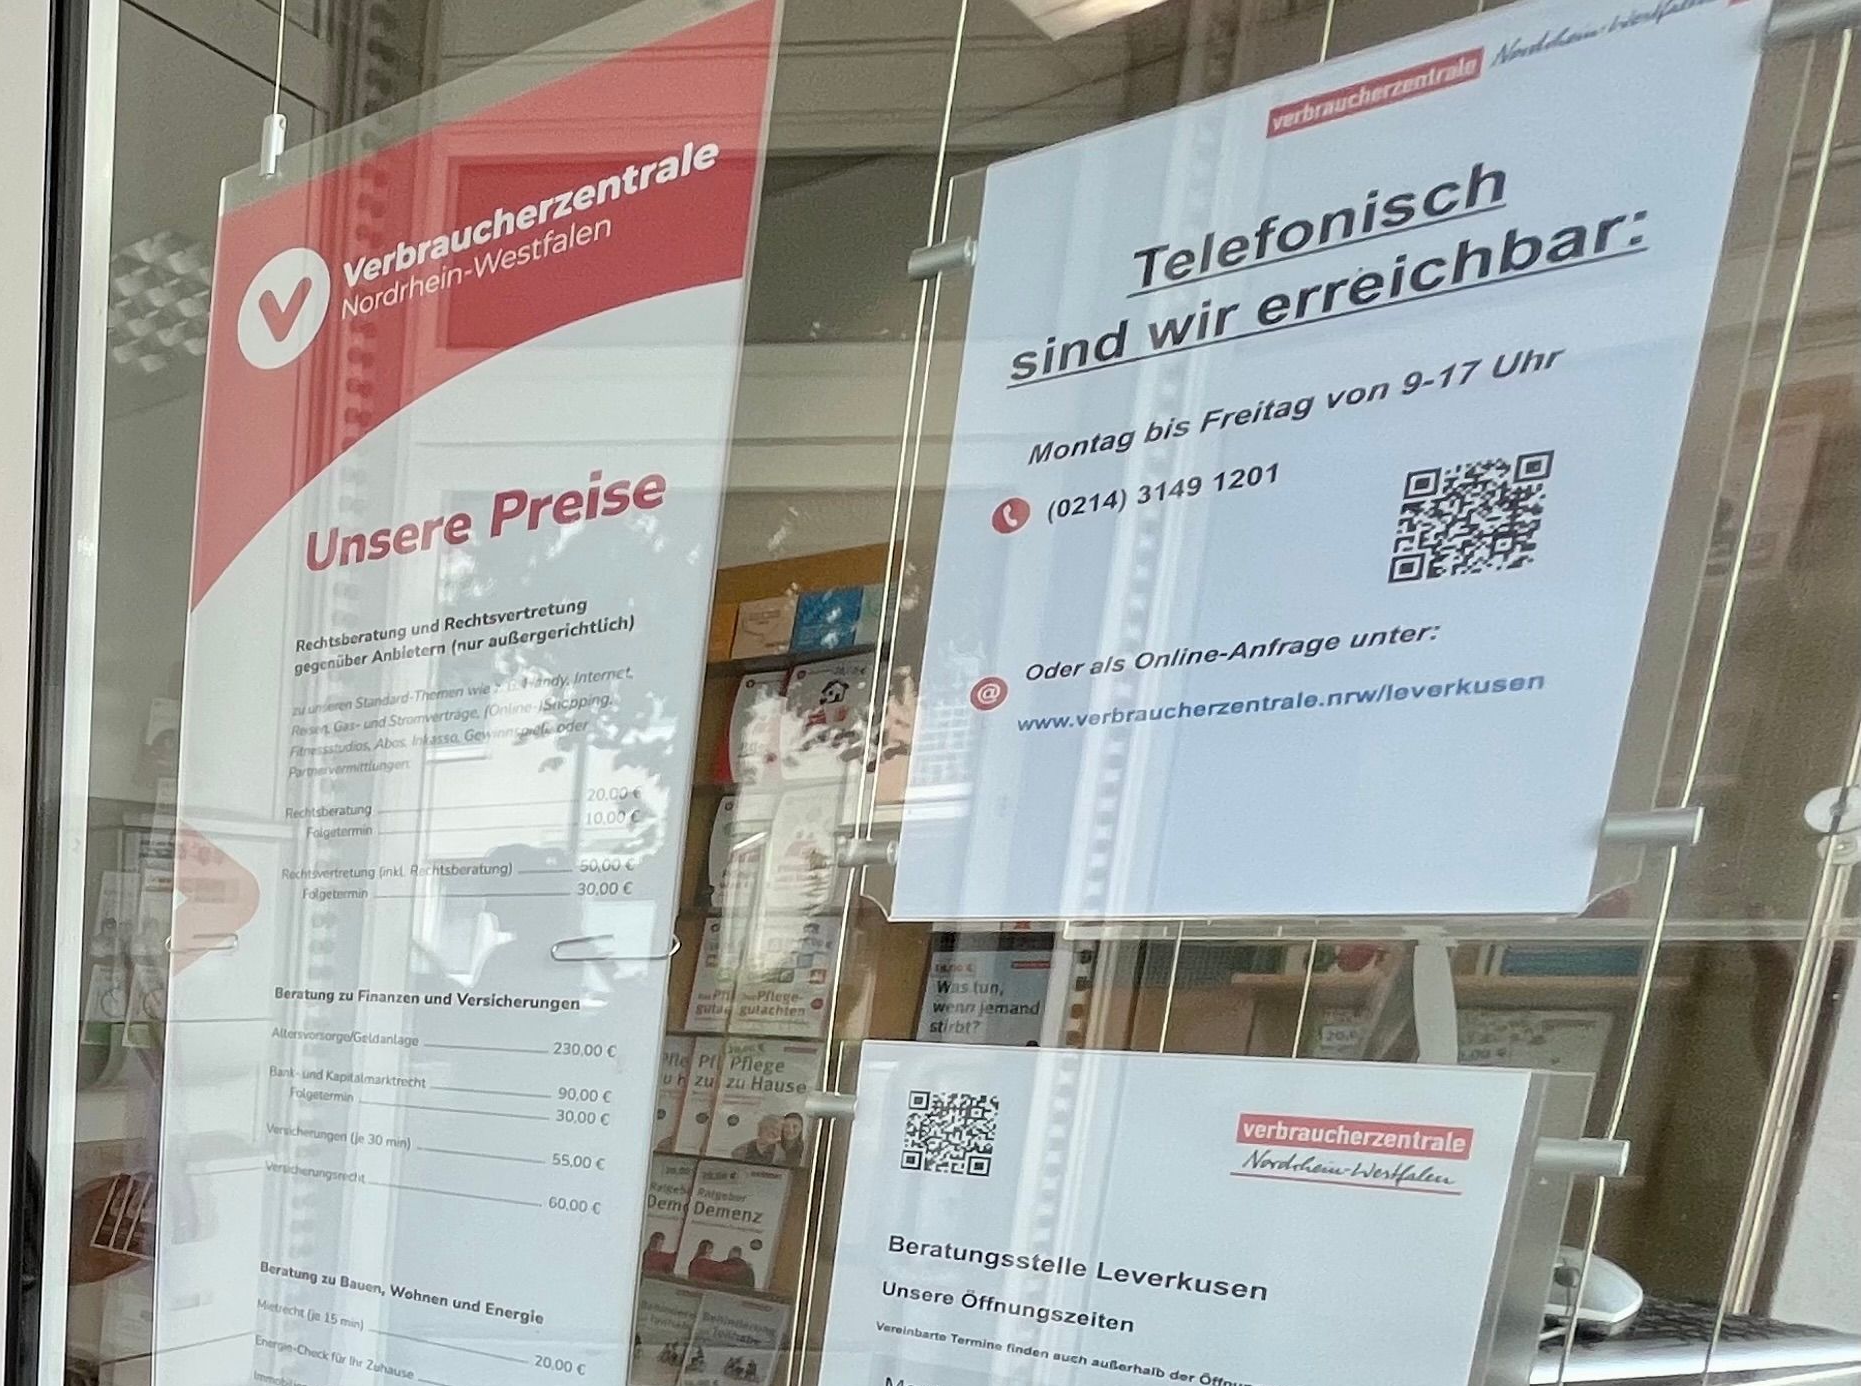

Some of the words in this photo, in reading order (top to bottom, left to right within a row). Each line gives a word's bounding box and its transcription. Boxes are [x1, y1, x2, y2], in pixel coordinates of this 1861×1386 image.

[1271, 57, 1479, 132] verbraucherzentrale
[342, 141, 720, 288] Verbraucherzentrale
[1133, 162, 1507, 289] Telefonisch
[341, 218, 612, 320] Nordrhein-Westfalen
[1010, 319, 1129, 381] sind
[1148, 299, 1240, 350] wir
[1257, 210, 1648, 327] erreichbar:
[1027, 429, 1136, 466] Montag
[1143, 417, 1191, 443] bis
[1200, 395, 1316, 433] Freitag
[1326, 382, 1390, 409] von
[1402, 358, 1483, 396] 9-17
[1491, 348, 1567, 379] Uhr
[1047, 487, 1127, 524] (0214)
[1137, 475, 1202, 505] 3149
[1213, 462, 1280, 492] 1201
[305, 511, 472, 572] Unsere
[489, 469, 667, 538] Preise
[294, 652, 367, 677] gegenüber
[371, 642, 446, 664] Anbietern
[451, 637, 485, 657] (nur
[488, 614, 636, 648] außergerichtlich)
[295, 626, 407, 653] Rechtsberatung
[411, 618, 440, 636] und
[444, 599, 588, 632] Rechtsvertretung
[1025, 660, 1086, 681] Oder
[1089, 656, 1126, 676] als
[1134, 634, 1341, 671] Online-Anfrage
[1349, 624, 1441, 650] unter:
[556, 720, 589, 734] oder
[1016, 674, 1546, 732] www.verbraucherzentrale.nrw/leverkusen
[285, 803, 373, 820] Rechtsberatung
[282, 865, 376, 882] Rechtsvertretung
[410, 861, 514, 878] Rechtsberatung)
[302, 886, 369, 903] Folgetermin
[577, 881, 618, 898] 30,00
[274, 986, 335, 1004] Beratung
[338, 990, 355, 1002] zu
[357, 988, 421, 1006] Finanzen
[424, 991, 452, 1006] und
[456, 993, 581, 1013] Versicherungen
[738, 1003, 806, 1018] gutachten
[933, 1002, 975, 1014] wenn
[980, 1000, 1041, 1017] jemand
[937, 979, 967, 995] Was
[272, 1027, 419, 1048] Altersvorsorge/Geldanlage
[552, 1041, 603, 1058] 230,00
[929, 1018, 982, 1035] stirbt?
[301, 1067, 324, 1081] und
[325, 1069, 427, 1089] Kapitalmarktrecht
[558, 1087, 599, 1103] 90,00
[725, 1077, 746, 1090] zu
[751, 1075, 809, 1095] Hause
[730, 1055, 786, 1076] Pflege
[289, 1086, 355, 1104] Folgetermin
[556, 1109, 597, 1126] 30,00
[266, 1122, 348, 1145] Versicherungen
[368, 1133, 383, 1146] 30
[385, 1134, 412, 1151] min)
[552, 1153, 592, 1170] 55,00
[1243, 1119, 1468, 1154] verbraucherzentrale
[265, 1160, 366, 1184] Versicherungsrecht
[548, 1196, 588, 1214] 60,00
[1241, 1149, 1457, 1188] Nordrhein-Westfalen
[693, 1200, 764, 1225] Demenz
[888, 1234, 1088, 1278] Beratungsstelle
[1096, 1261, 1269, 1302] Leverkusen
[259, 1260, 318, 1285] Beratung
[321, 1273, 337, 1287] zu
[340, 1275, 386, 1297] Bauen,
[389, 1284, 449, 1308] Wohnen
[453, 1296, 481, 1313] und
[485, 1301, 544, 1326] Energie
[882, 1280, 954, 1307] Unsere
[961, 1288, 1136, 1333] Öffnungszeiten
[255, 1334, 330, 1363] Energie-Check
[331, 1350, 347, 1366] für
[348, 1354, 364, 1368] Ihr
[366, 1358, 415, 1381] Zuhause
[257, 1298, 305, 1320] Mietrecht
[324, 1312, 338, 1326] 15
[534, 1354, 574, 1374] 20,00
[876, 1321, 947, 1343] Vereinbarte
[951, 1333, 1003, 1353] Termine
[1006, 1342, 1050, 1360] finden
[1053, 1350, 1088, 1367] auch
[1091, 1358, 1166, 1379] außerhalb
[1169, 1369, 1196, 1384] der
